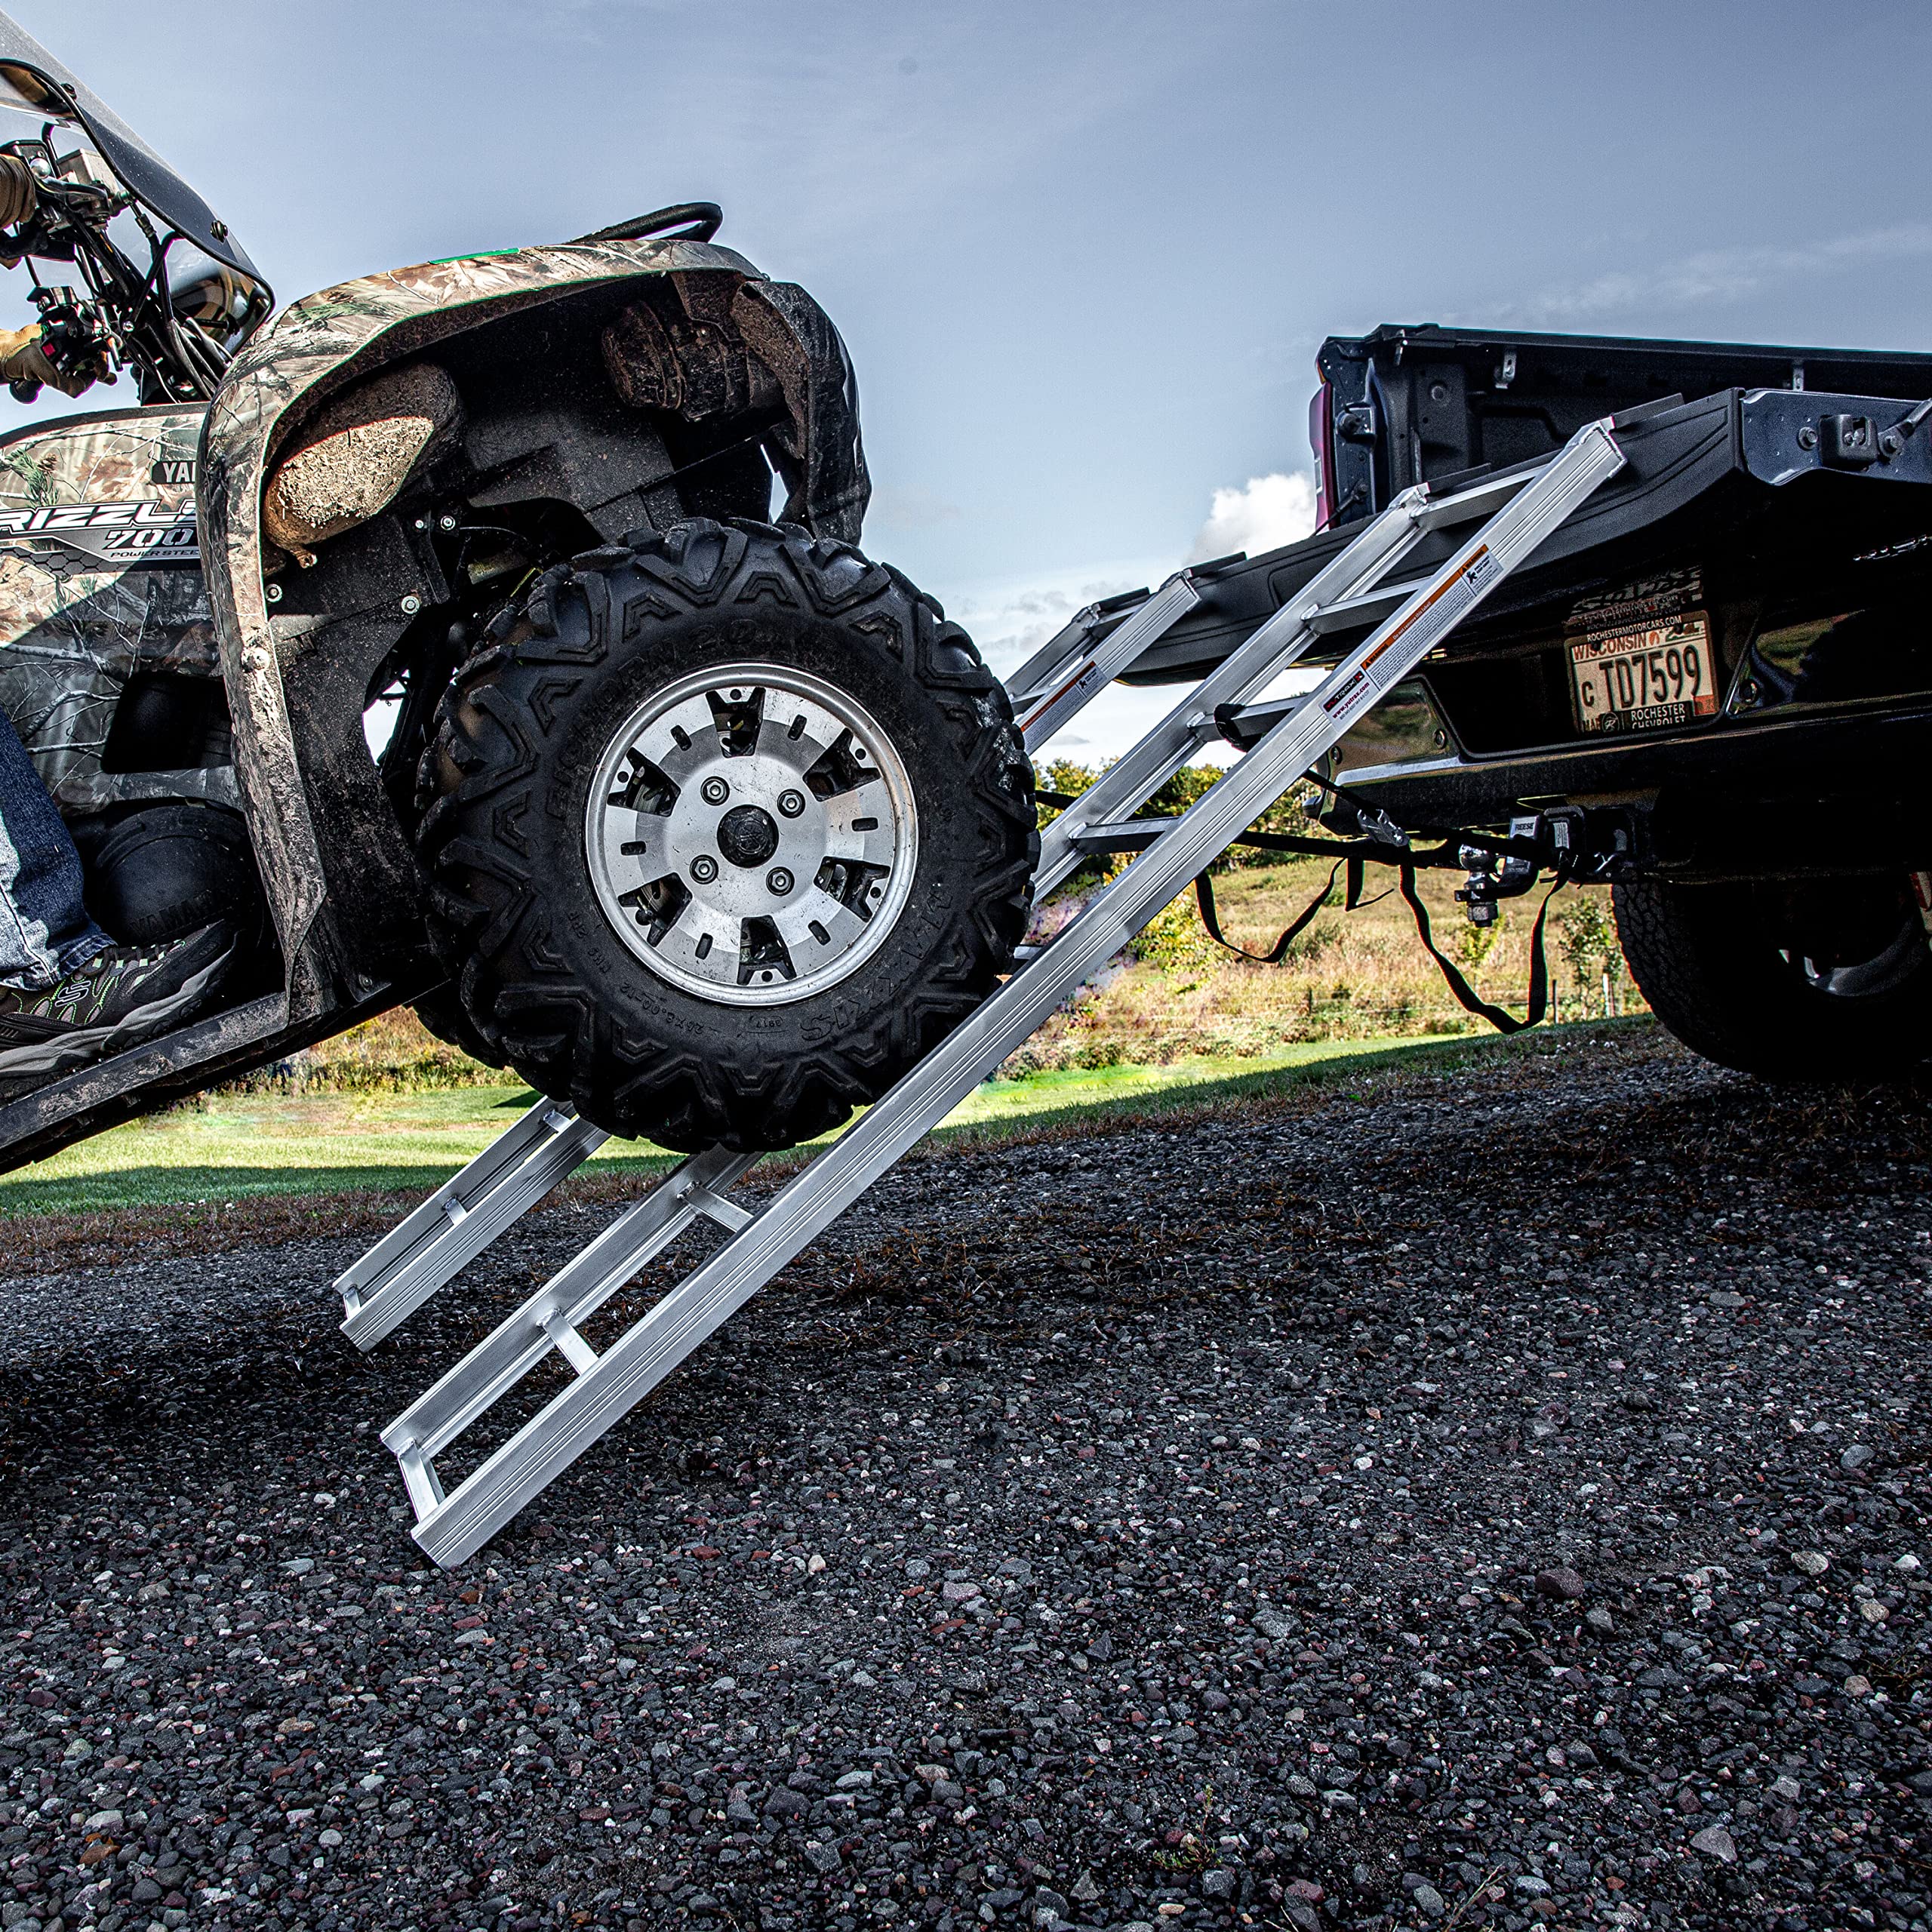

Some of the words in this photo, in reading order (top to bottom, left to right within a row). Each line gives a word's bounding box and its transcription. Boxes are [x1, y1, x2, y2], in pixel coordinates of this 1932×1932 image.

[105, 528, 194, 549] 700
[110, 549, 160, 558] POWER
[1403, 616, 1417, 629] remove
[1586, 615, 1682, 643] ROCHESTERMOTORCARS.COM
[1572, 632, 1647, 660] WISCONSIN
[1581, 681, 1595, 707] C
[1598, 645, 1701, 713] TD7599
[1332, 681, 1370, 718] www.yutrax.com
[1631, 703, 1685, 721] ROCHESTER
[1515, 822, 1534, 831] REESE
[801, 891, 953, 1041] MAXXIS
